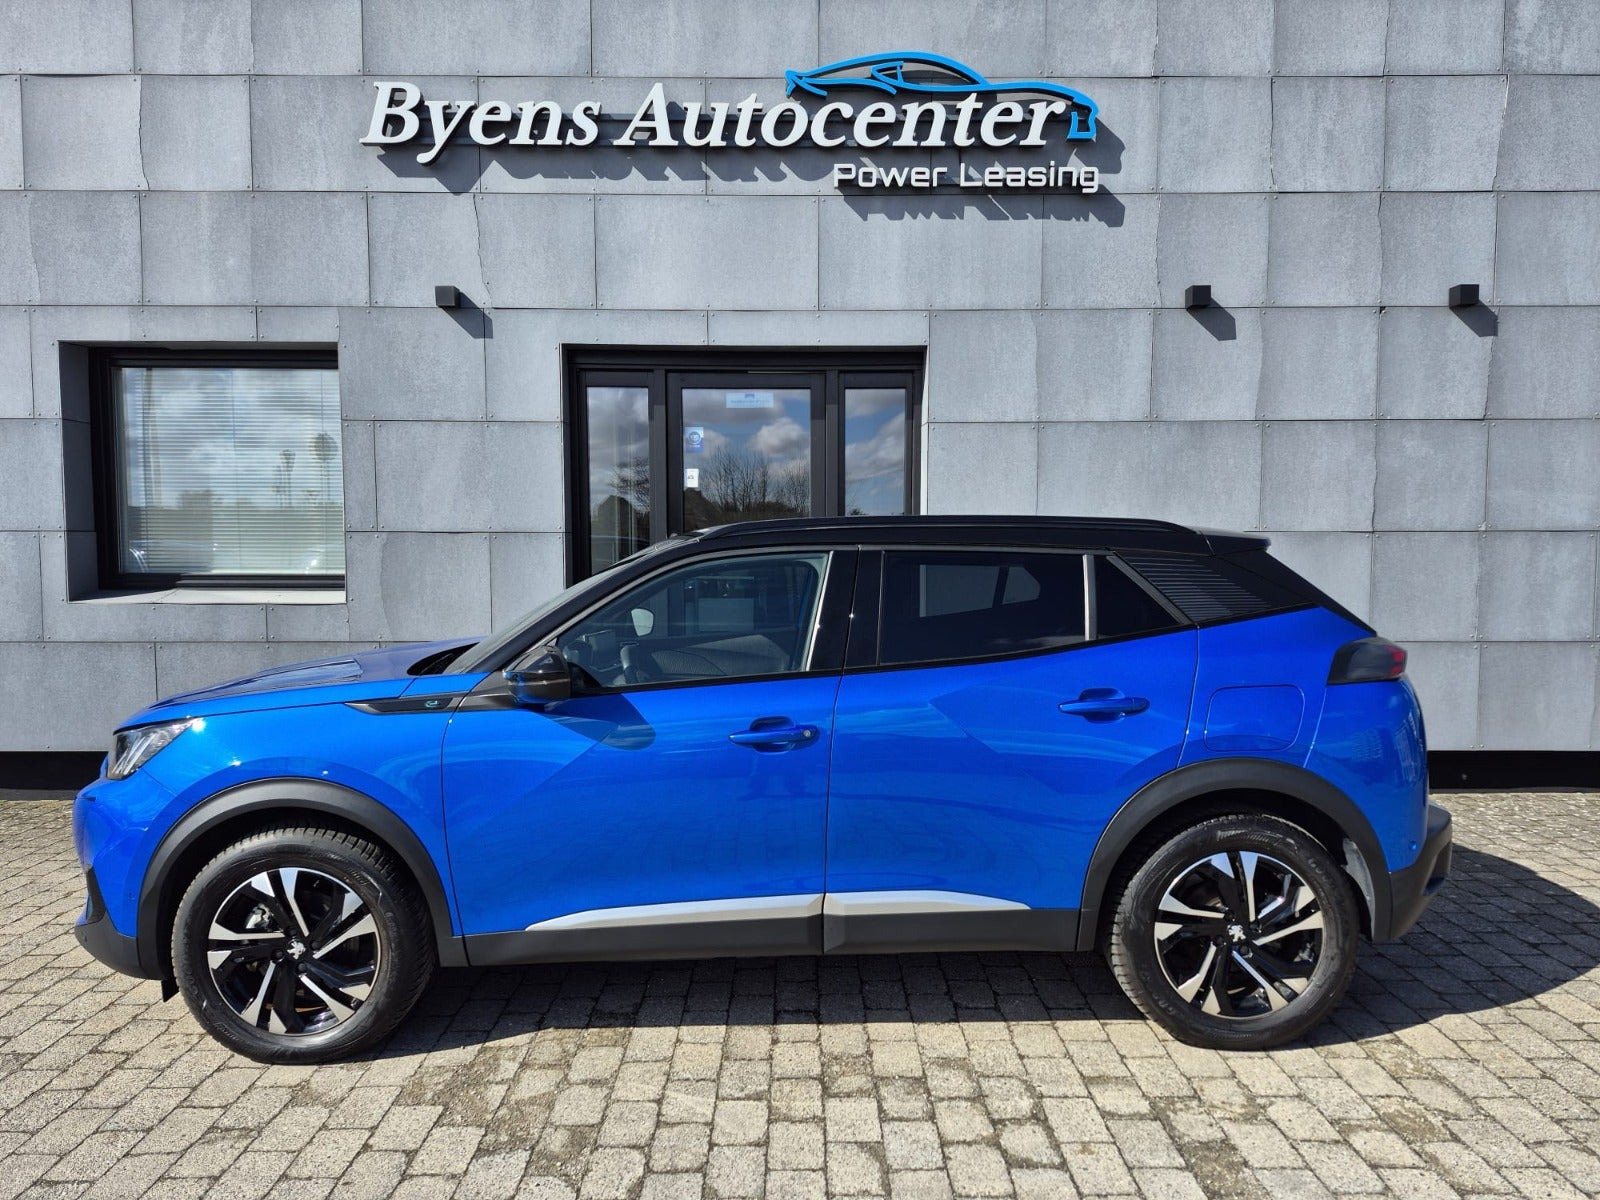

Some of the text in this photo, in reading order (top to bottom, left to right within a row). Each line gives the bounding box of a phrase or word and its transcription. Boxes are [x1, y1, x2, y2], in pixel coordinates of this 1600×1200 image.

[359, 81, 1067, 166] Byens Autocenter
[833, 161, 1100, 194] Power Leasing
